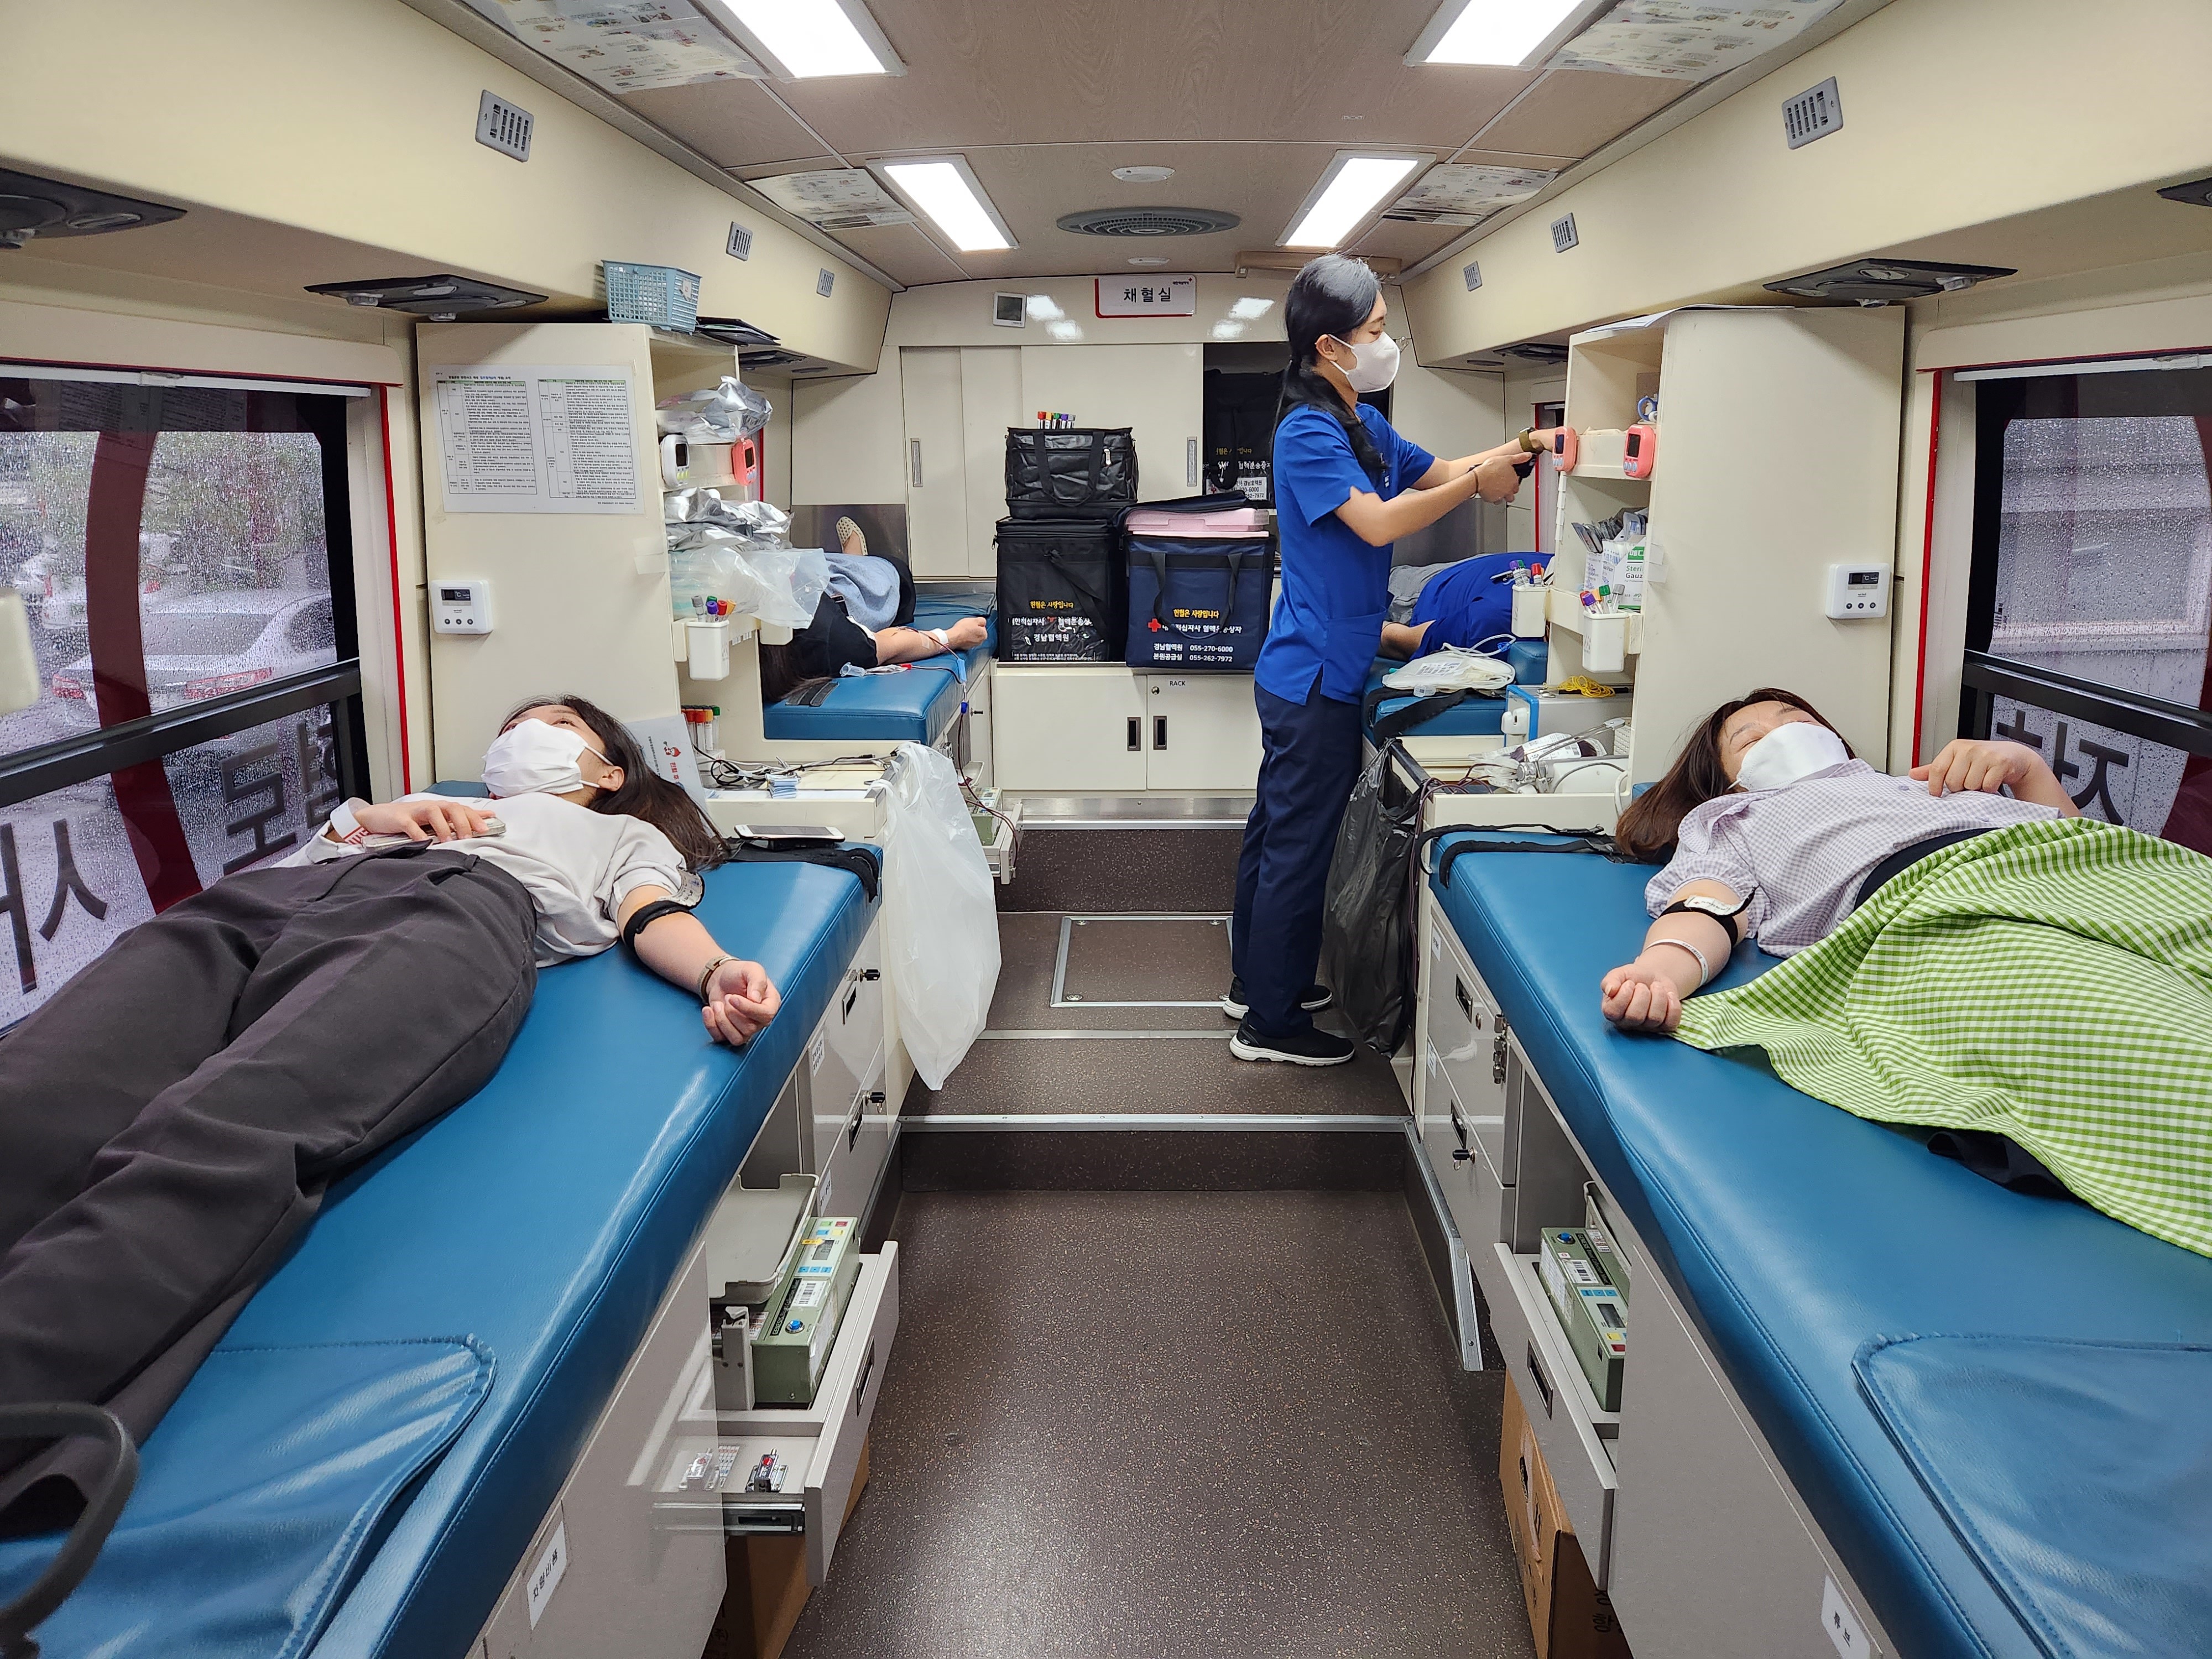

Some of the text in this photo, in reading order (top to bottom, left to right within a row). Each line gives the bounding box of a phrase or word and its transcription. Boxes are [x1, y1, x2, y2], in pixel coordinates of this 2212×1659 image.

[1030, 601, 1073, 609] 헌혈은 사랑입니다
[1173, 609, 1219, 619] 헌혈은 사랑입니다
[1034, 633, 1069, 642] 경남혈액원
[1189, 654, 1233, 662] 055-262-7972
